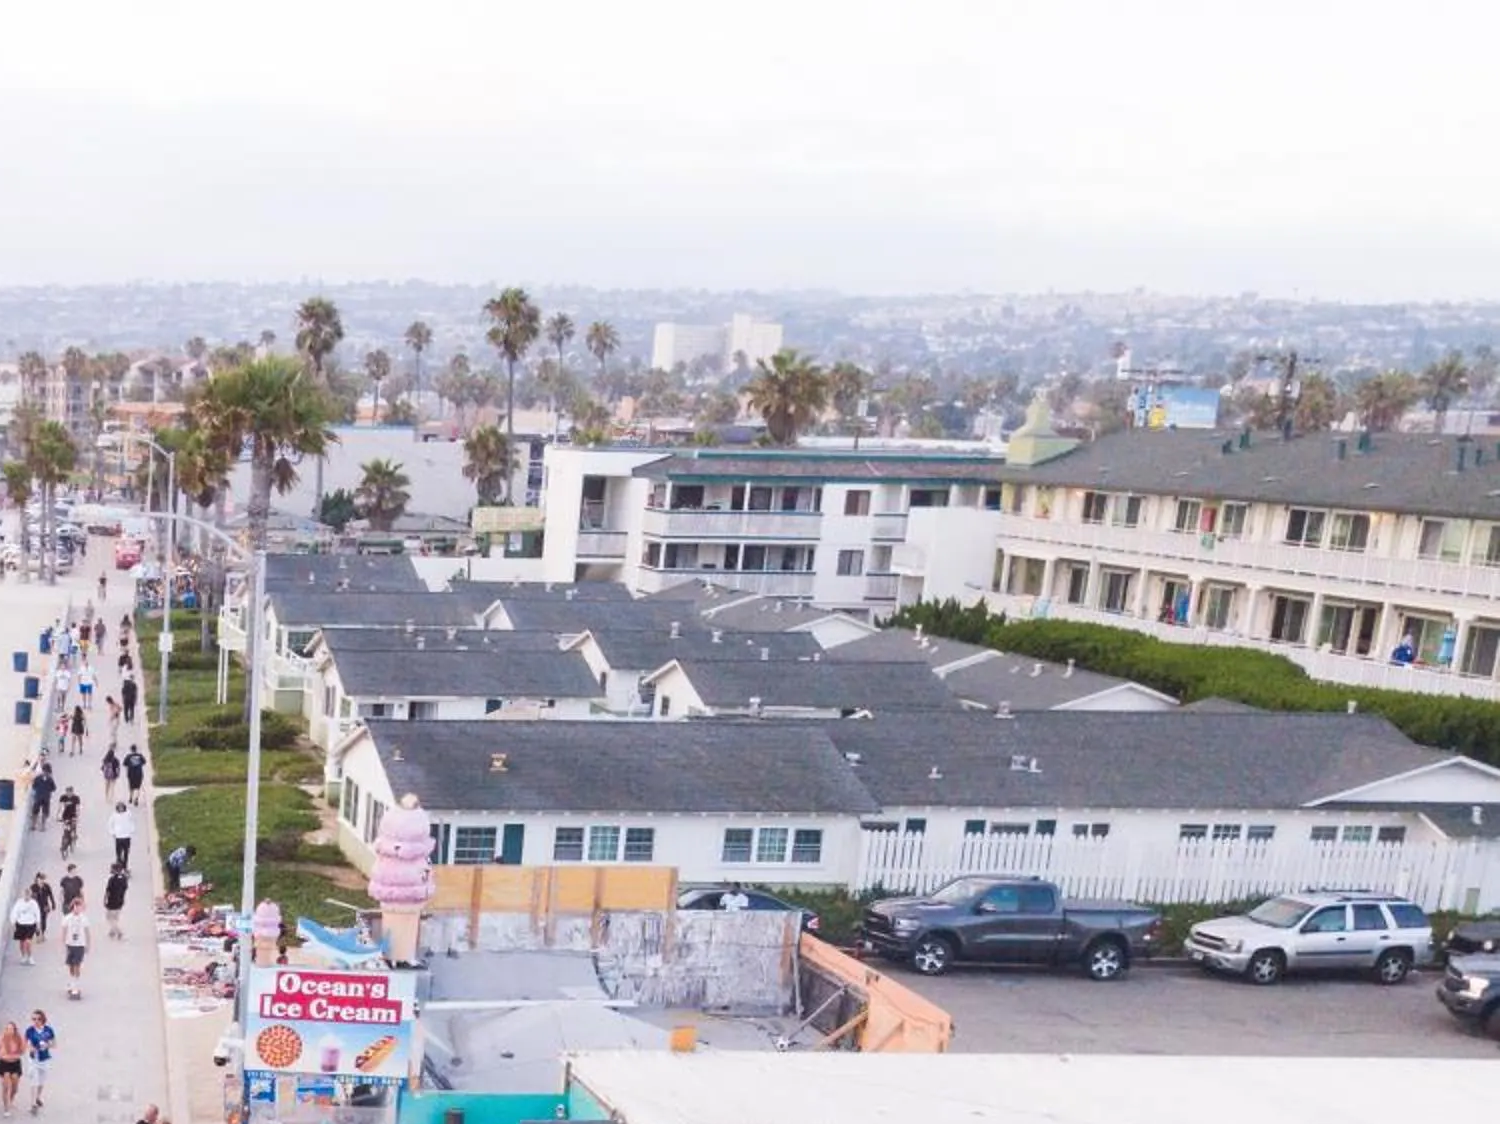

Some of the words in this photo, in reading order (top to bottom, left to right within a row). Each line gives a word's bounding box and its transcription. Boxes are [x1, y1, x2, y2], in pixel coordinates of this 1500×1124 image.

[278, 973, 385, 998] Ocean's
[262, 995, 302, 1017] Ice
[309, 998, 398, 1023] Cream
